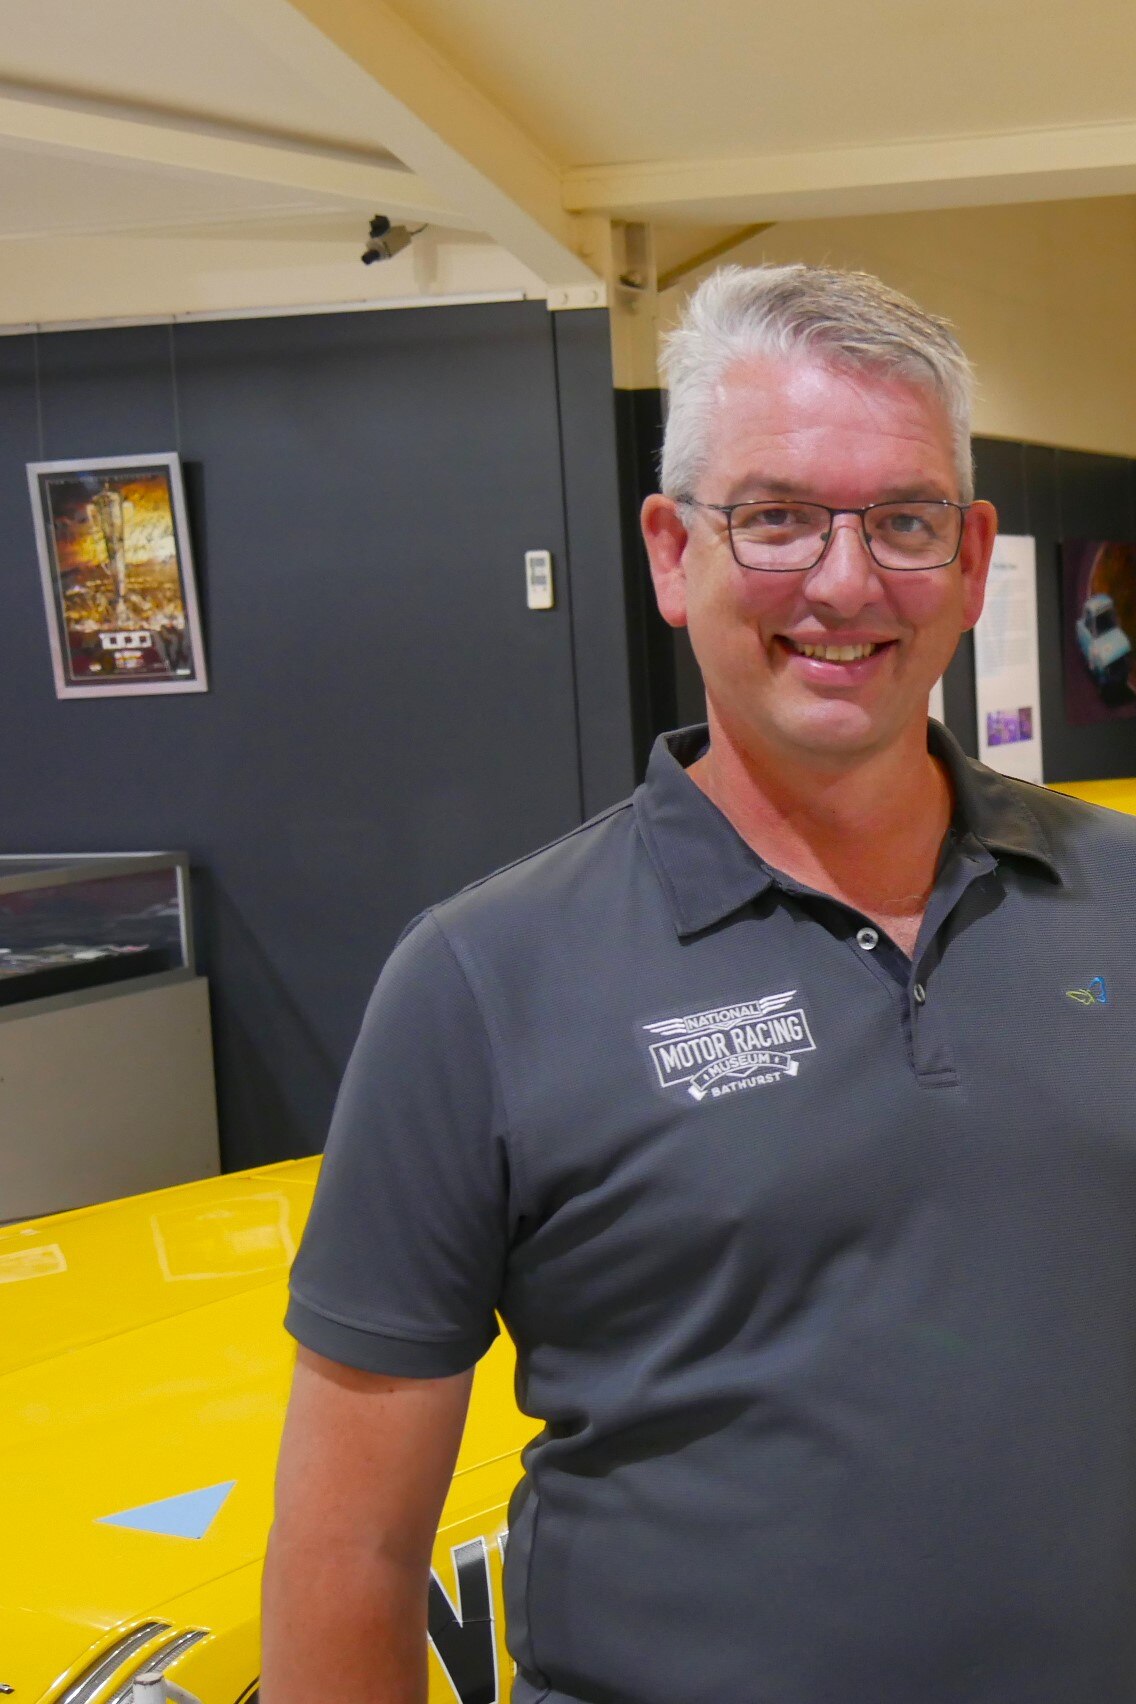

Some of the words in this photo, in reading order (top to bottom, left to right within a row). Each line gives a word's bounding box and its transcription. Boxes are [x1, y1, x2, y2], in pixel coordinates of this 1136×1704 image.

[687, 1003, 760, 1030] NATIONAL
[658, 1033, 730, 1074] MOTOR
[731, 1016, 804, 1053] RACING
[708, 1052, 771, 1077] MUSEUM
[711, 1072, 782, 1098] BATHURST
